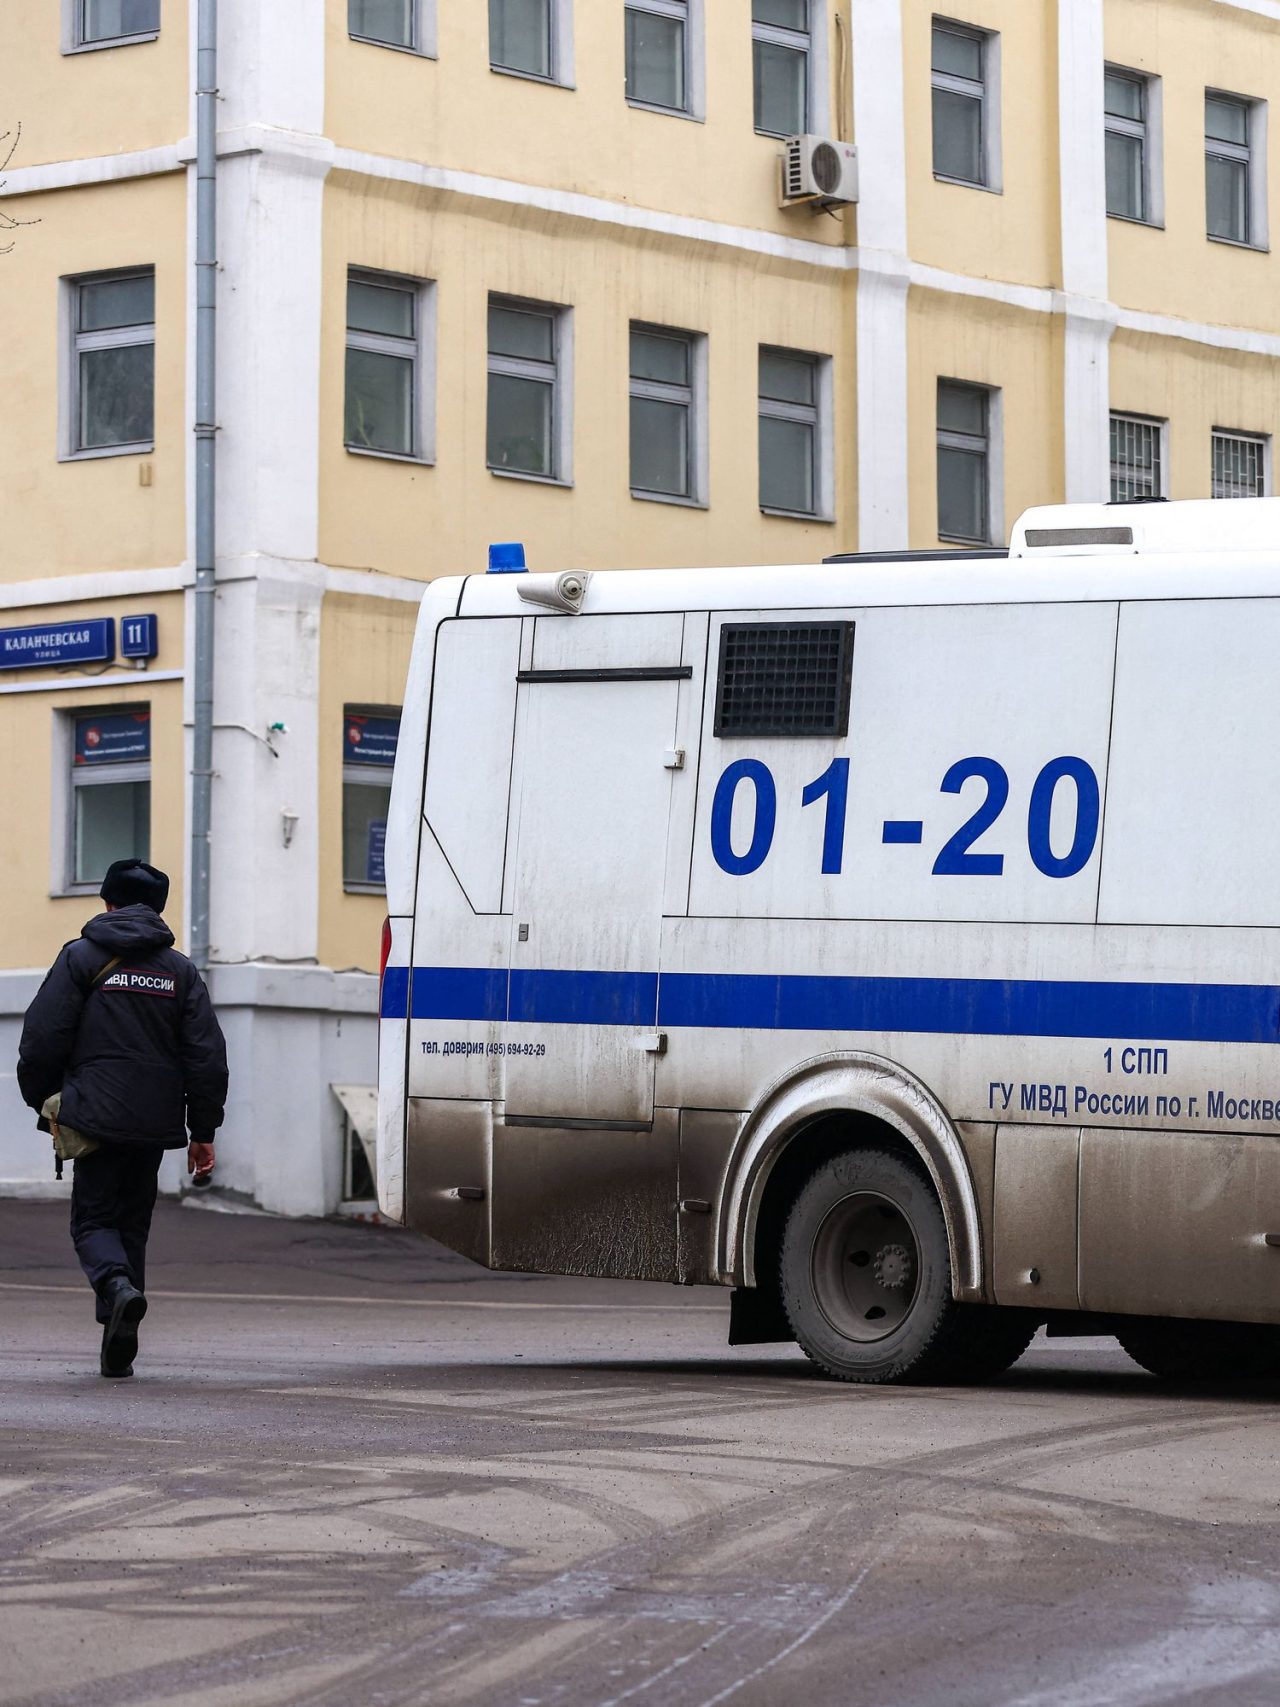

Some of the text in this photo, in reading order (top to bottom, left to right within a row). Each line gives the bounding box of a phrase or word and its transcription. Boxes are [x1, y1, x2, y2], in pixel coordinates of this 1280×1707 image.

[5, 630, 90, 651] КАЛАНЧЕВСКАЯ
[128, 624, 142, 643] 11
[711, 756, 1100, 878] 01-20
[131, 975, 174, 991] РОССИИ
[421, 1041, 546, 1058] тел. доверия (495) 694-92-29
[1103, 1047, 1168, 1075] 1 СПП
[989, 1082, 1014, 1109] ГУ
[1020, 1083, 1067, 1118] МВД
[1074, 1085, 1149, 1116] России
[1156, 1095, 1181, 1117] по
[1187, 1096, 1200, 1117] г.
